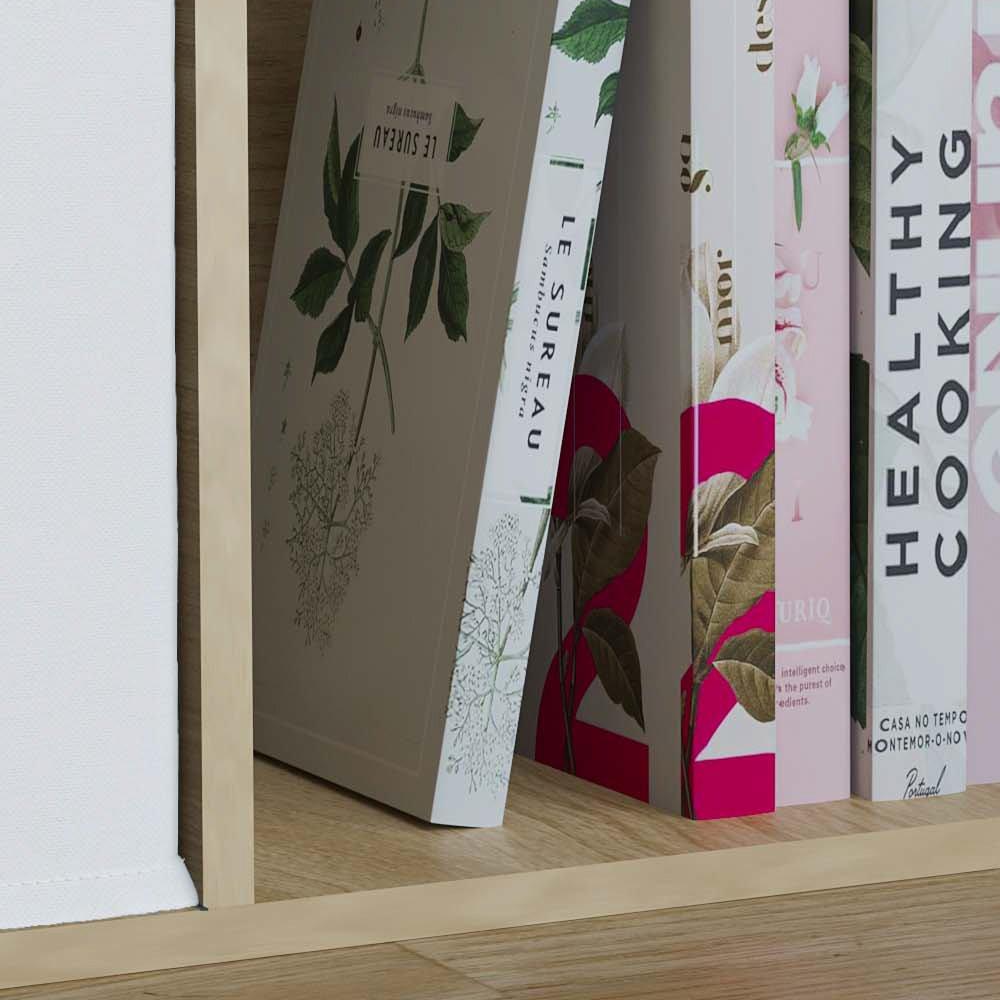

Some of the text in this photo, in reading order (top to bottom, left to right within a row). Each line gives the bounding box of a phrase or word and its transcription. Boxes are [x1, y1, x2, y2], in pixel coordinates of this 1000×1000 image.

[373, 125, 437, 159] LE SUREAU
[517, 242, 553, 418] Sambucus nigra
[527, 215, 576, 450] LE SUREAU
[885, 134, 923, 577] HEALTHY
[935, 129, 972, 577] COOKING
[781, 664, 820, 678] intelligent
[785, 681, 797, 692] the
[799, 679, 823, 692] purest
[825, 677, 832, 688] of
[880, 709, 967, 732] CASA NO TEMPO
[903, 764, 947, 800] Portugal
